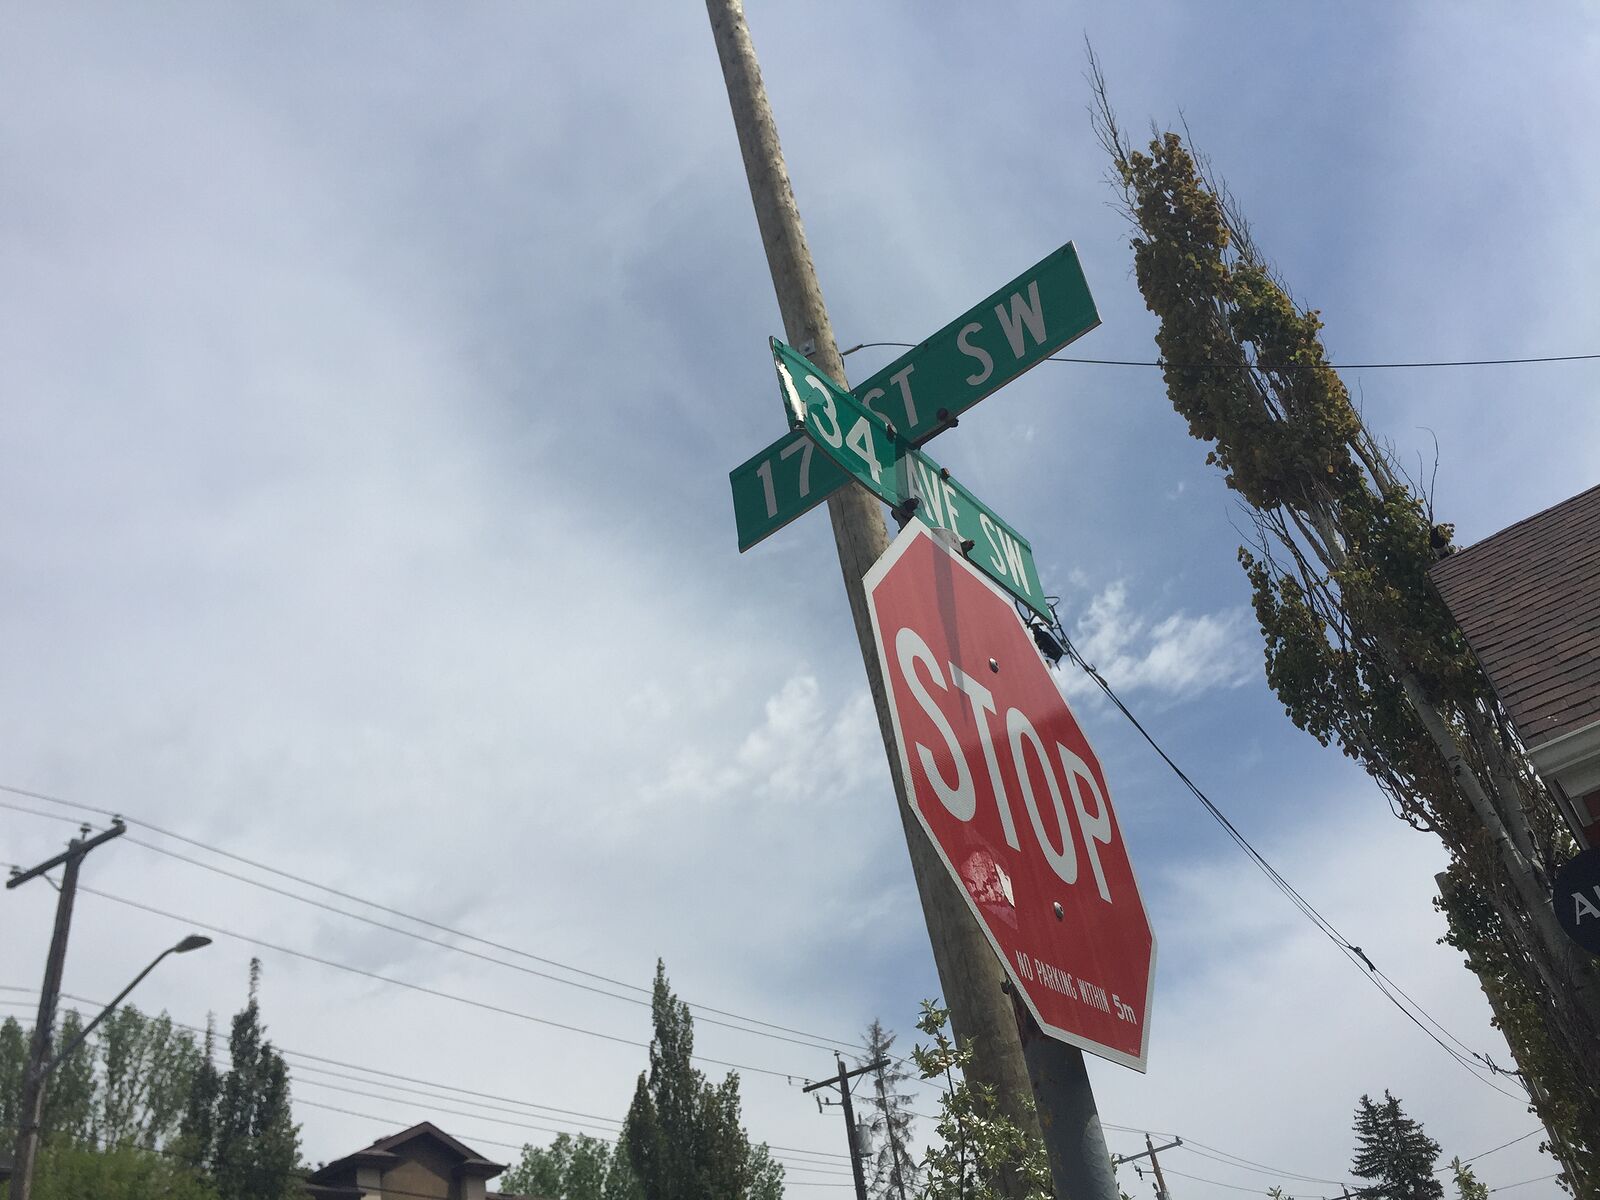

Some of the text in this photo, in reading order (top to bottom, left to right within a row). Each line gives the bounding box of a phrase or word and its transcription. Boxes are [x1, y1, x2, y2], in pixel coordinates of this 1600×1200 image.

[756, 280, 1047, 519] 17 ST SW
[805, 374, 1032, 596] 34 AVE SW
[895, 627, 1112, 904] STOP
[1015, 949, 1138, 1025] NO PARKING WITHIN 5m
